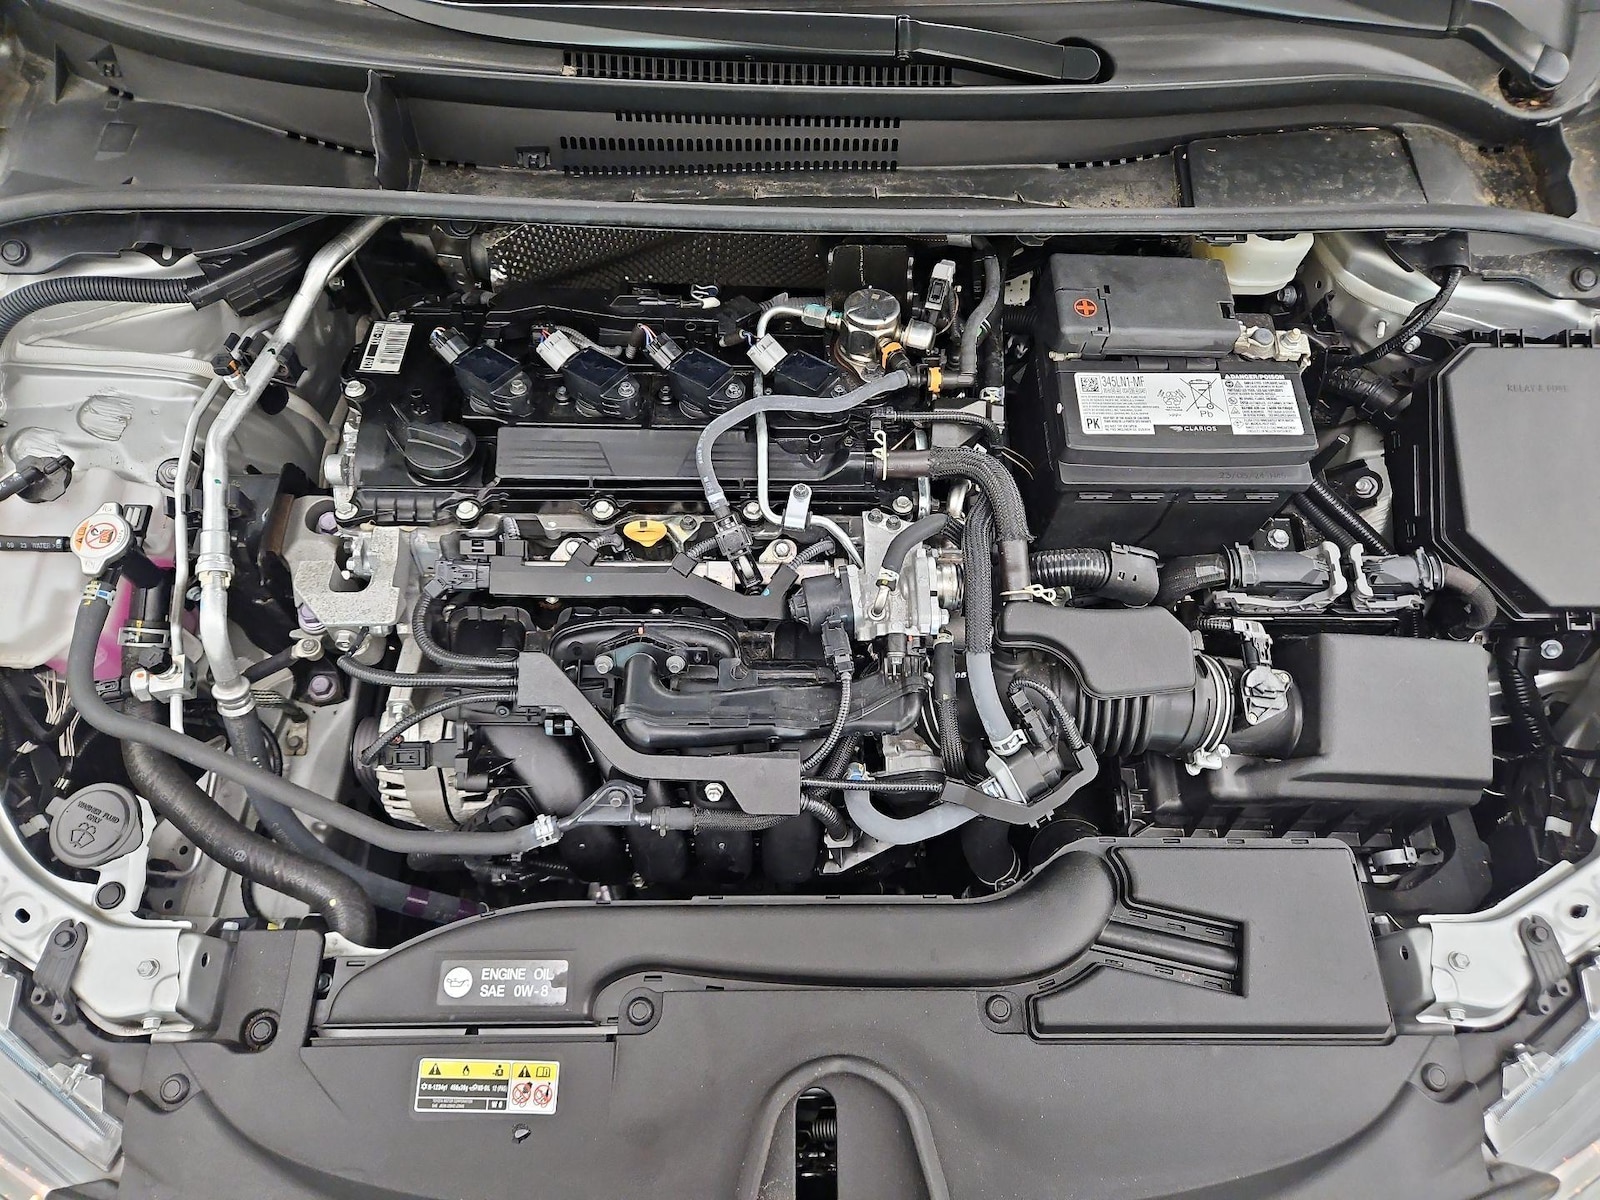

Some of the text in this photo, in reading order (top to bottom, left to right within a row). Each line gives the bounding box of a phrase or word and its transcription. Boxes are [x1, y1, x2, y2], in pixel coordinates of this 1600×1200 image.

[1101, 376, 1145, 387] 345LN1-MF
[1200, 410, 1214, 418] Pb
[1086, 418, 1101, 430] PK
[86, 814, 102, 824] ONLY
[102, 812, 120, 824] FLUID
[481, 968, 555, 980] ENGINE OIL
[480, 985, 549, 997] SAE 0W-8
